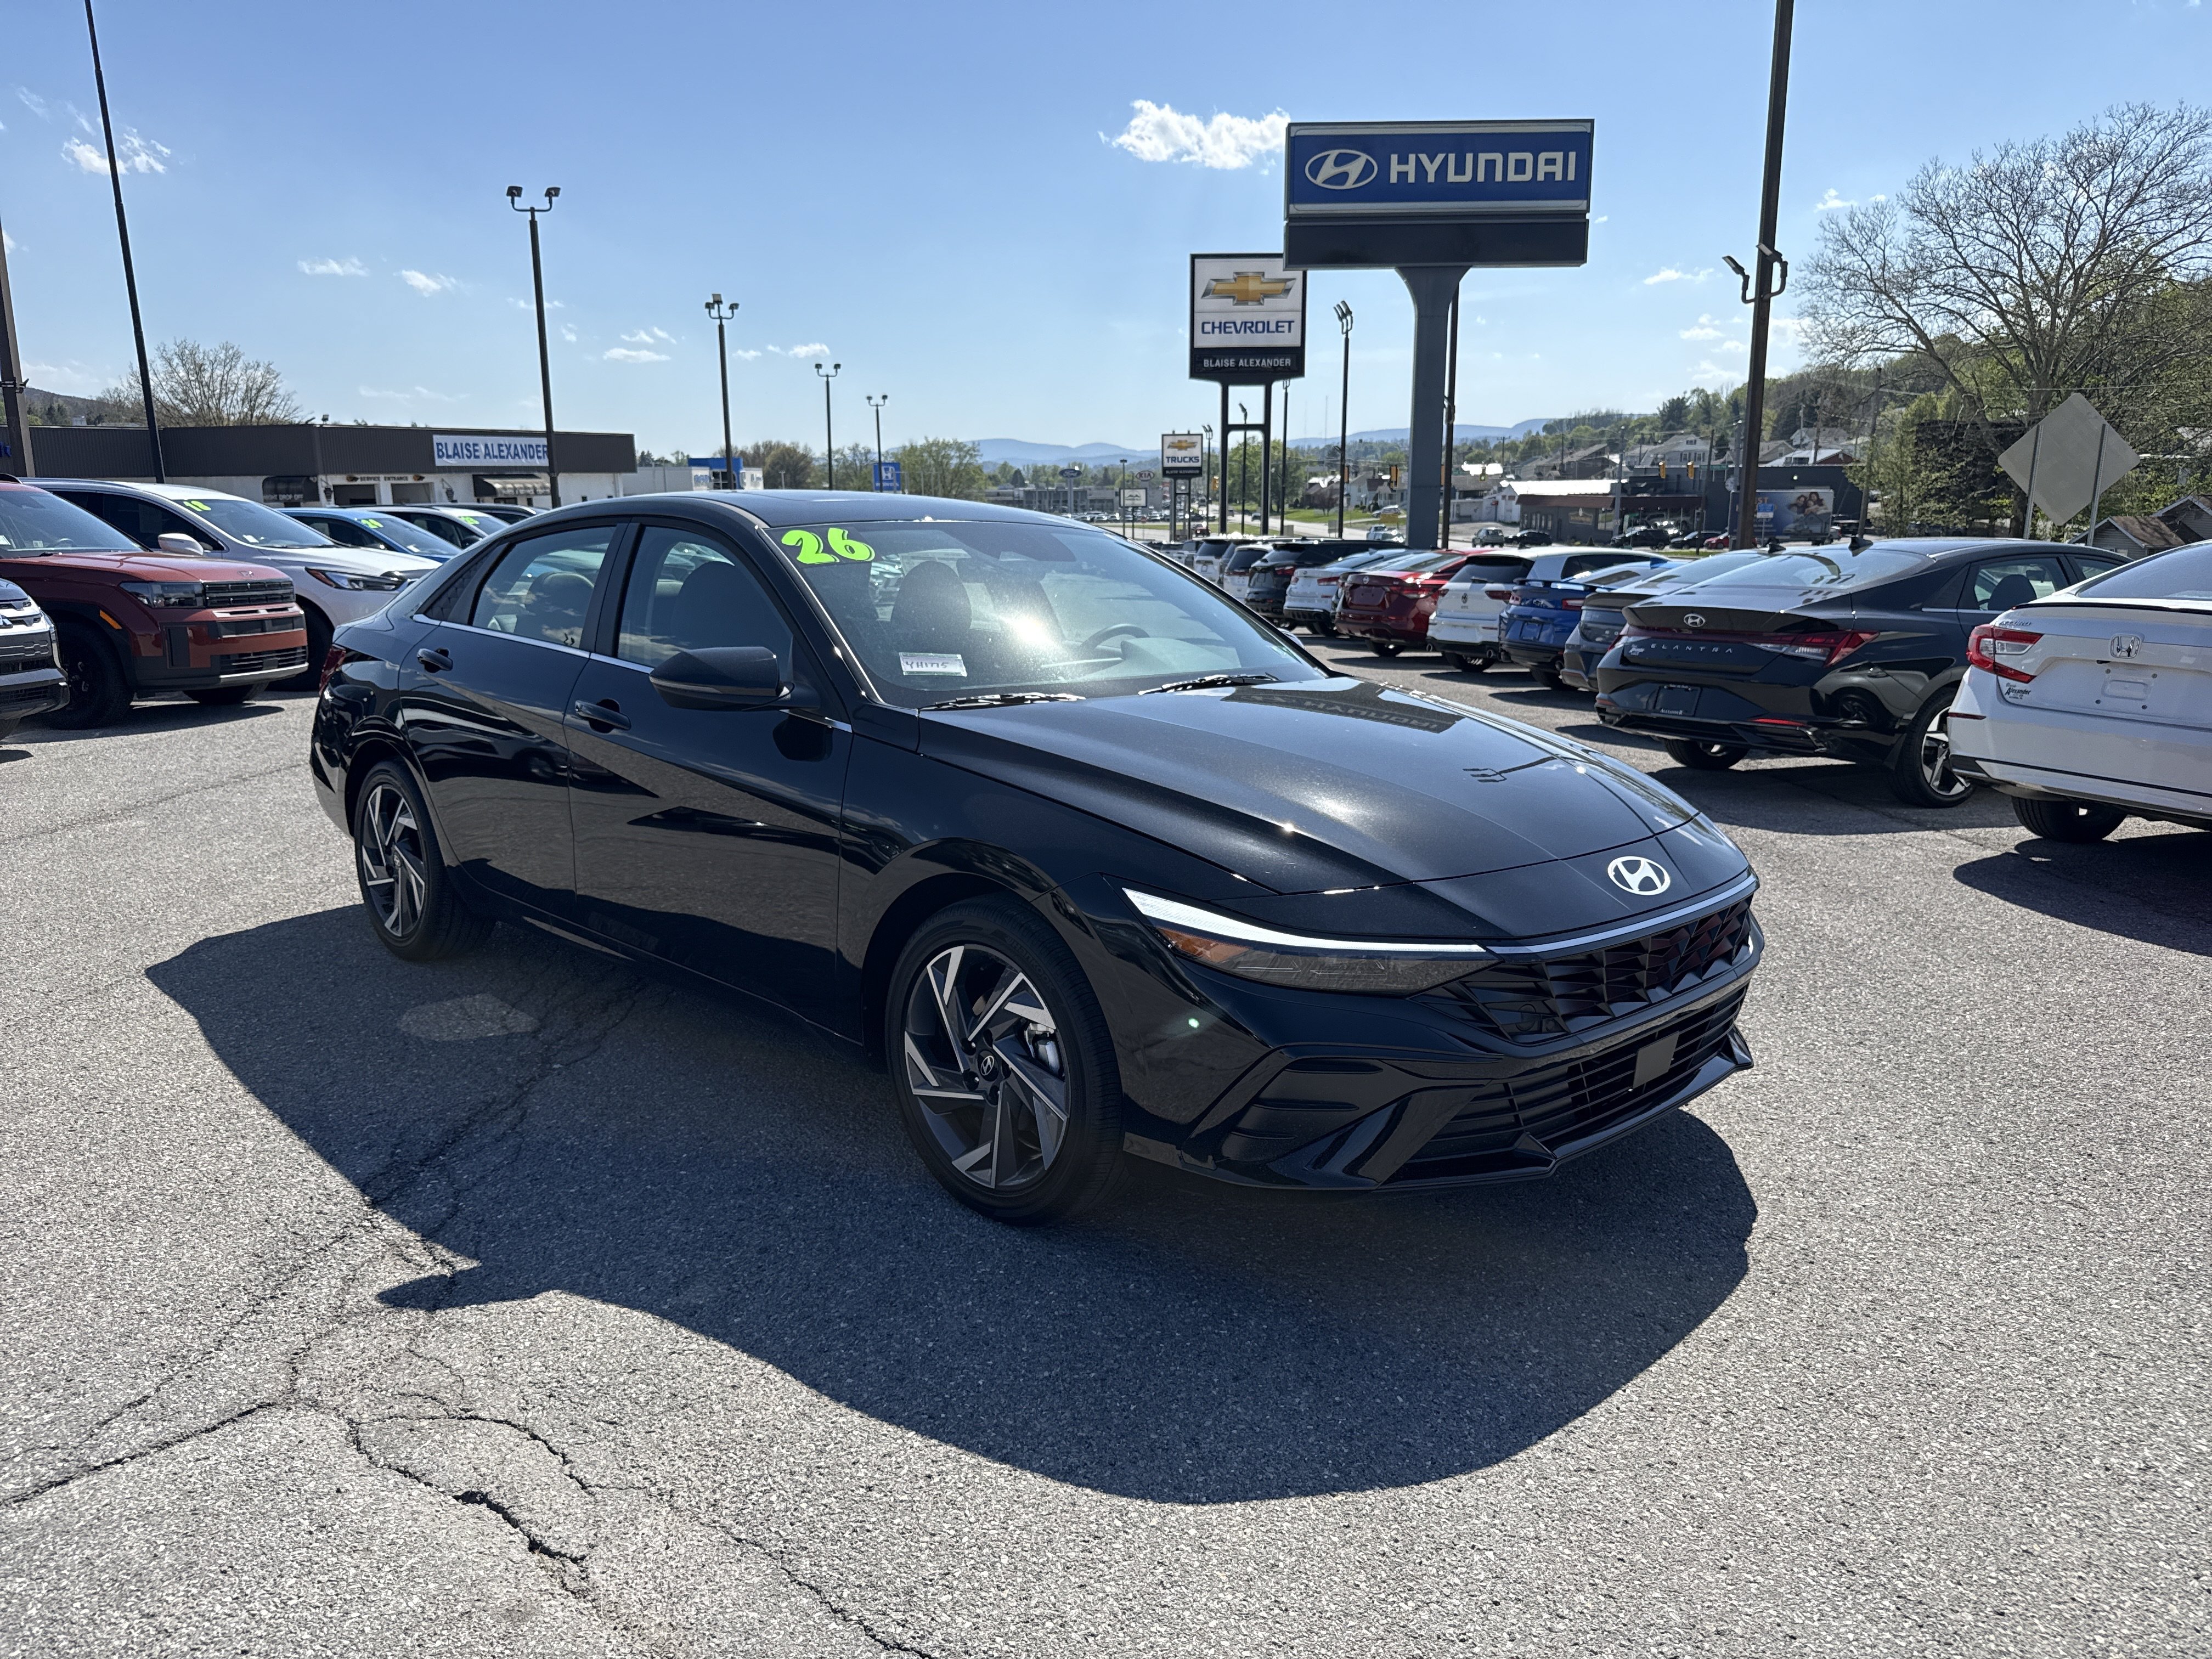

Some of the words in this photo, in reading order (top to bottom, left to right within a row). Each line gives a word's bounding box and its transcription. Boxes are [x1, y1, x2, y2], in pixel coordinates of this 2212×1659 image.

[1389, 151, 1577, 184] HYUNDAI
[1201, 320, 1295, 335] CHEVROLET
[1203, 359, 1235, 368] BLAISE
[1238, 358, 1291, 368] ALEXANDER
[436, 442, 481, 459] BLAISE
[483, 443, 549, 460] ALEXANDER
[781, 527, 876, 565] 26
[1650, 642, 1734, 654] ELANTRA
